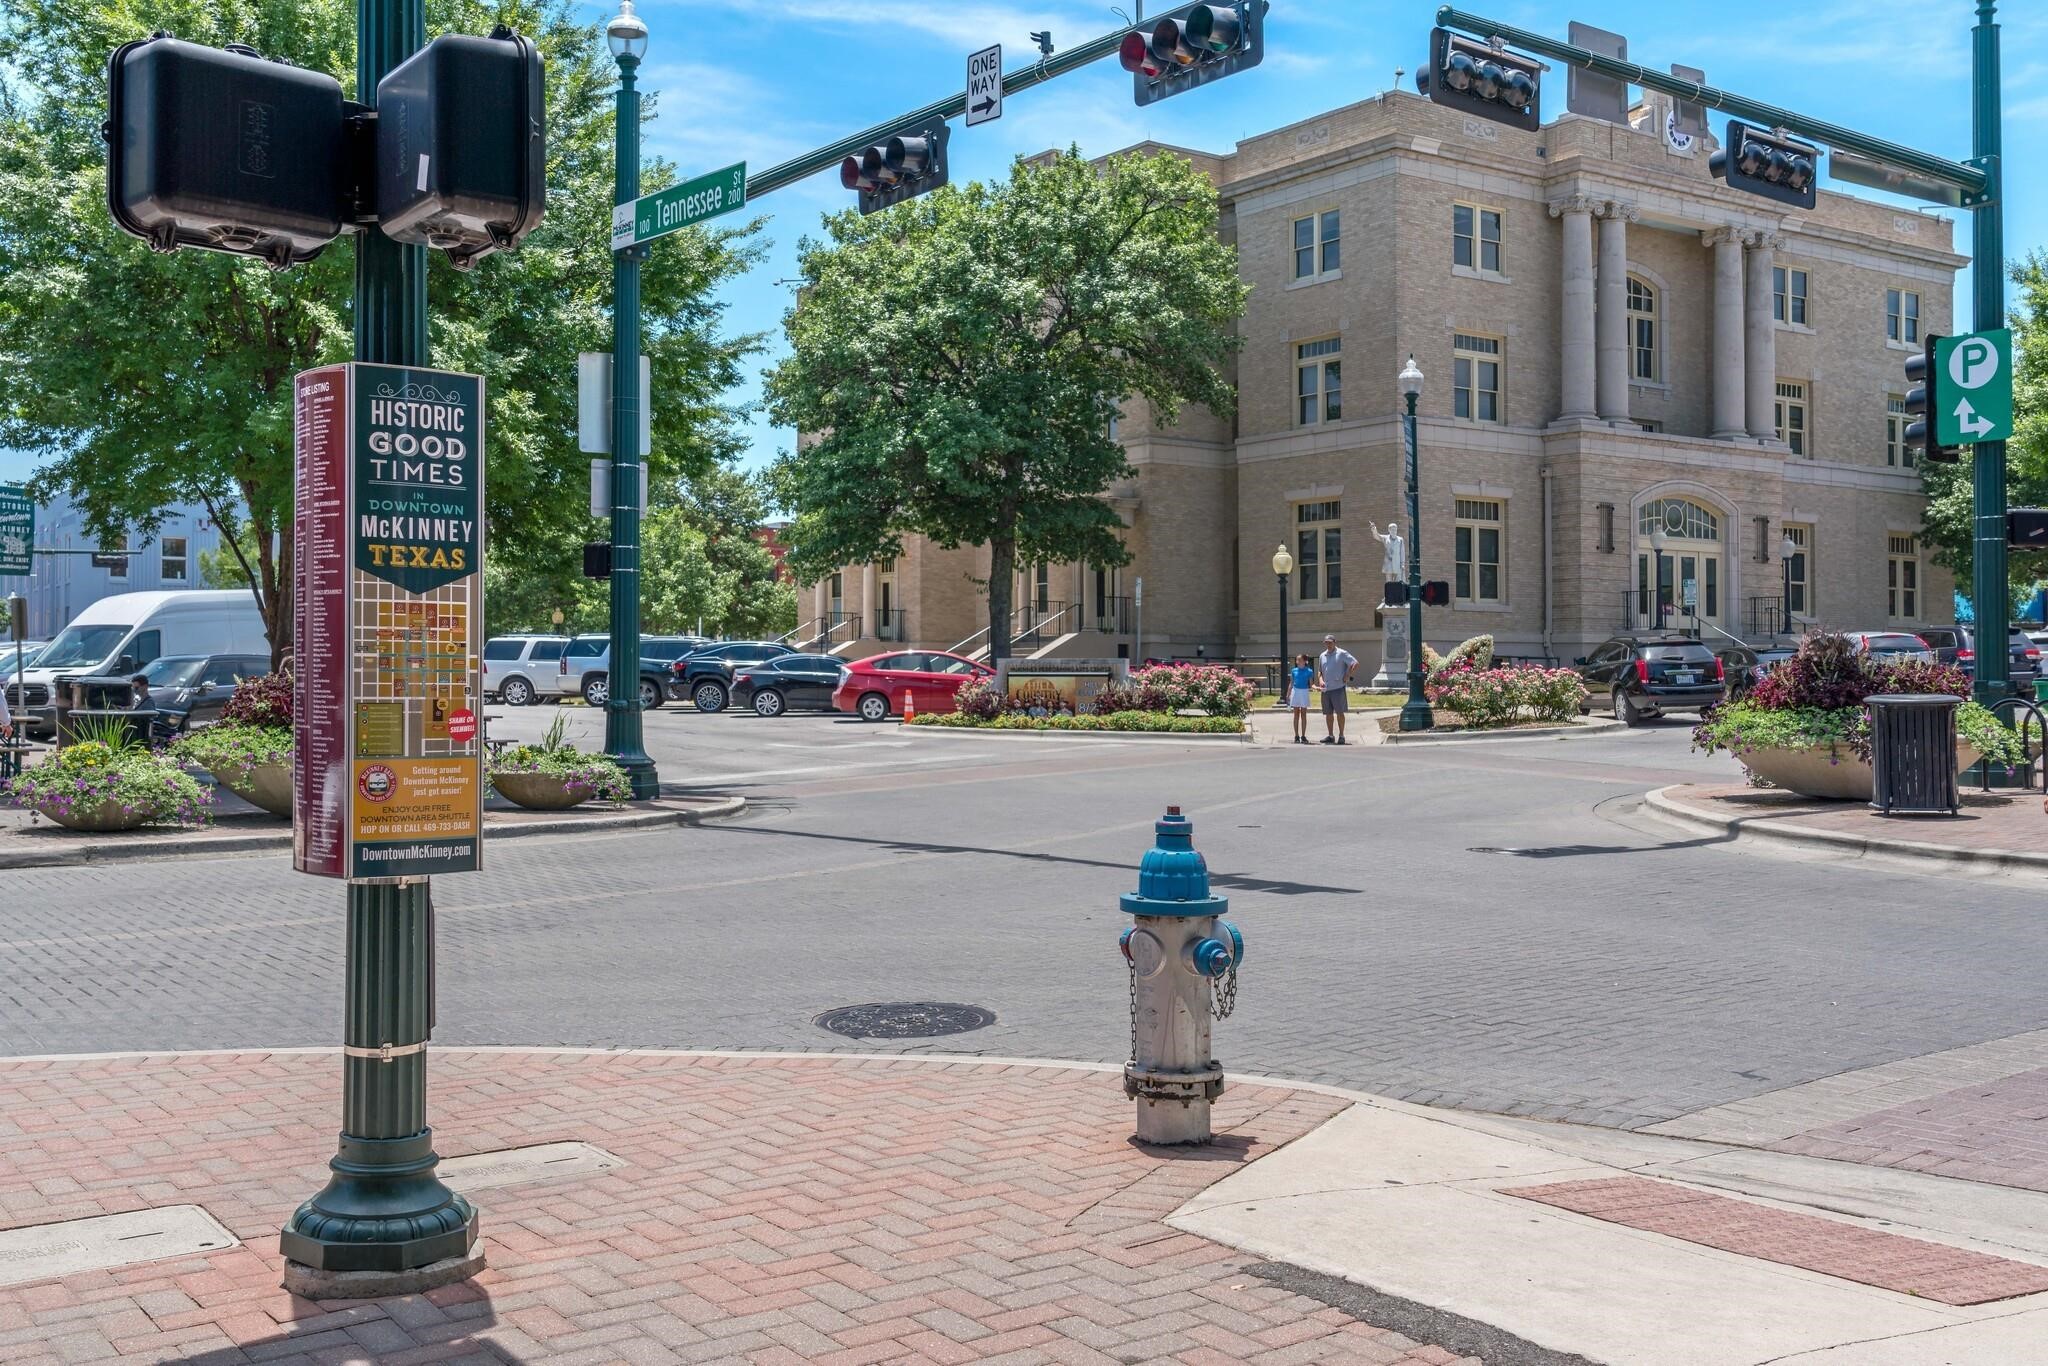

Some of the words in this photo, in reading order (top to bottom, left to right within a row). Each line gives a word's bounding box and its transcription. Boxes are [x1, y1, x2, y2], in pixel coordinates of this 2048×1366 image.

[972, 53, 996, 76] ONE
[971, 72, 997, 96] WAY
[733, 170, 741, 186] St
[728, 187, 741, 206] 200
[655, 185, 723, 229] Tennessee
[639, 218, 651, 235] 100
[1962, 343, 1988, 384] P
[300, 386, 311, 398] STORE
[311, 382, 330, 395] LISTING
[370, 399, 466, 433] HISTORIC
[368, 431, 467, 461] GOOD
[369, 458, 464, 485] TIMES
[413, 491, 424, 500] IN
[0, 502, 31, 511] STORIC
[368, 499, 465, 516] DOWNTOWN
[361, 515, 473, 544] McKINNEY
[368, 544, 467, 570] TEXAS
[449, 716, 466, 724] SHAME
[412, 766, 438, 776] Getting
[439, 765, 461, 774] around
[403, 777, 438, 785] Downtown
[439, 777, 469, 785] McKinney
[413, 787, 426, 797] just
[428, 788, 439, 797] got
[441, 787, 462, 795] easier!
[360, 815, 414, 823] DOWNTOWN
[415, 814, 437, 822] AREA
[438, 812, 471, 820] SHUTTLE
[382, 806, 411, 814] ENJOY
[412, 805, 430, 813] OUR
[432, 804, 451, 812] FREE
[360, 825, 377, 834] HOP
[379, 825, 389, 833] ON
[391, 824, 402, 833] OR
[404, 823, 421, 832] CALL
[422, 820, 471, 832] 469-733-DASH
[362, 844, 471, 861] DowntownMcKinney.com
